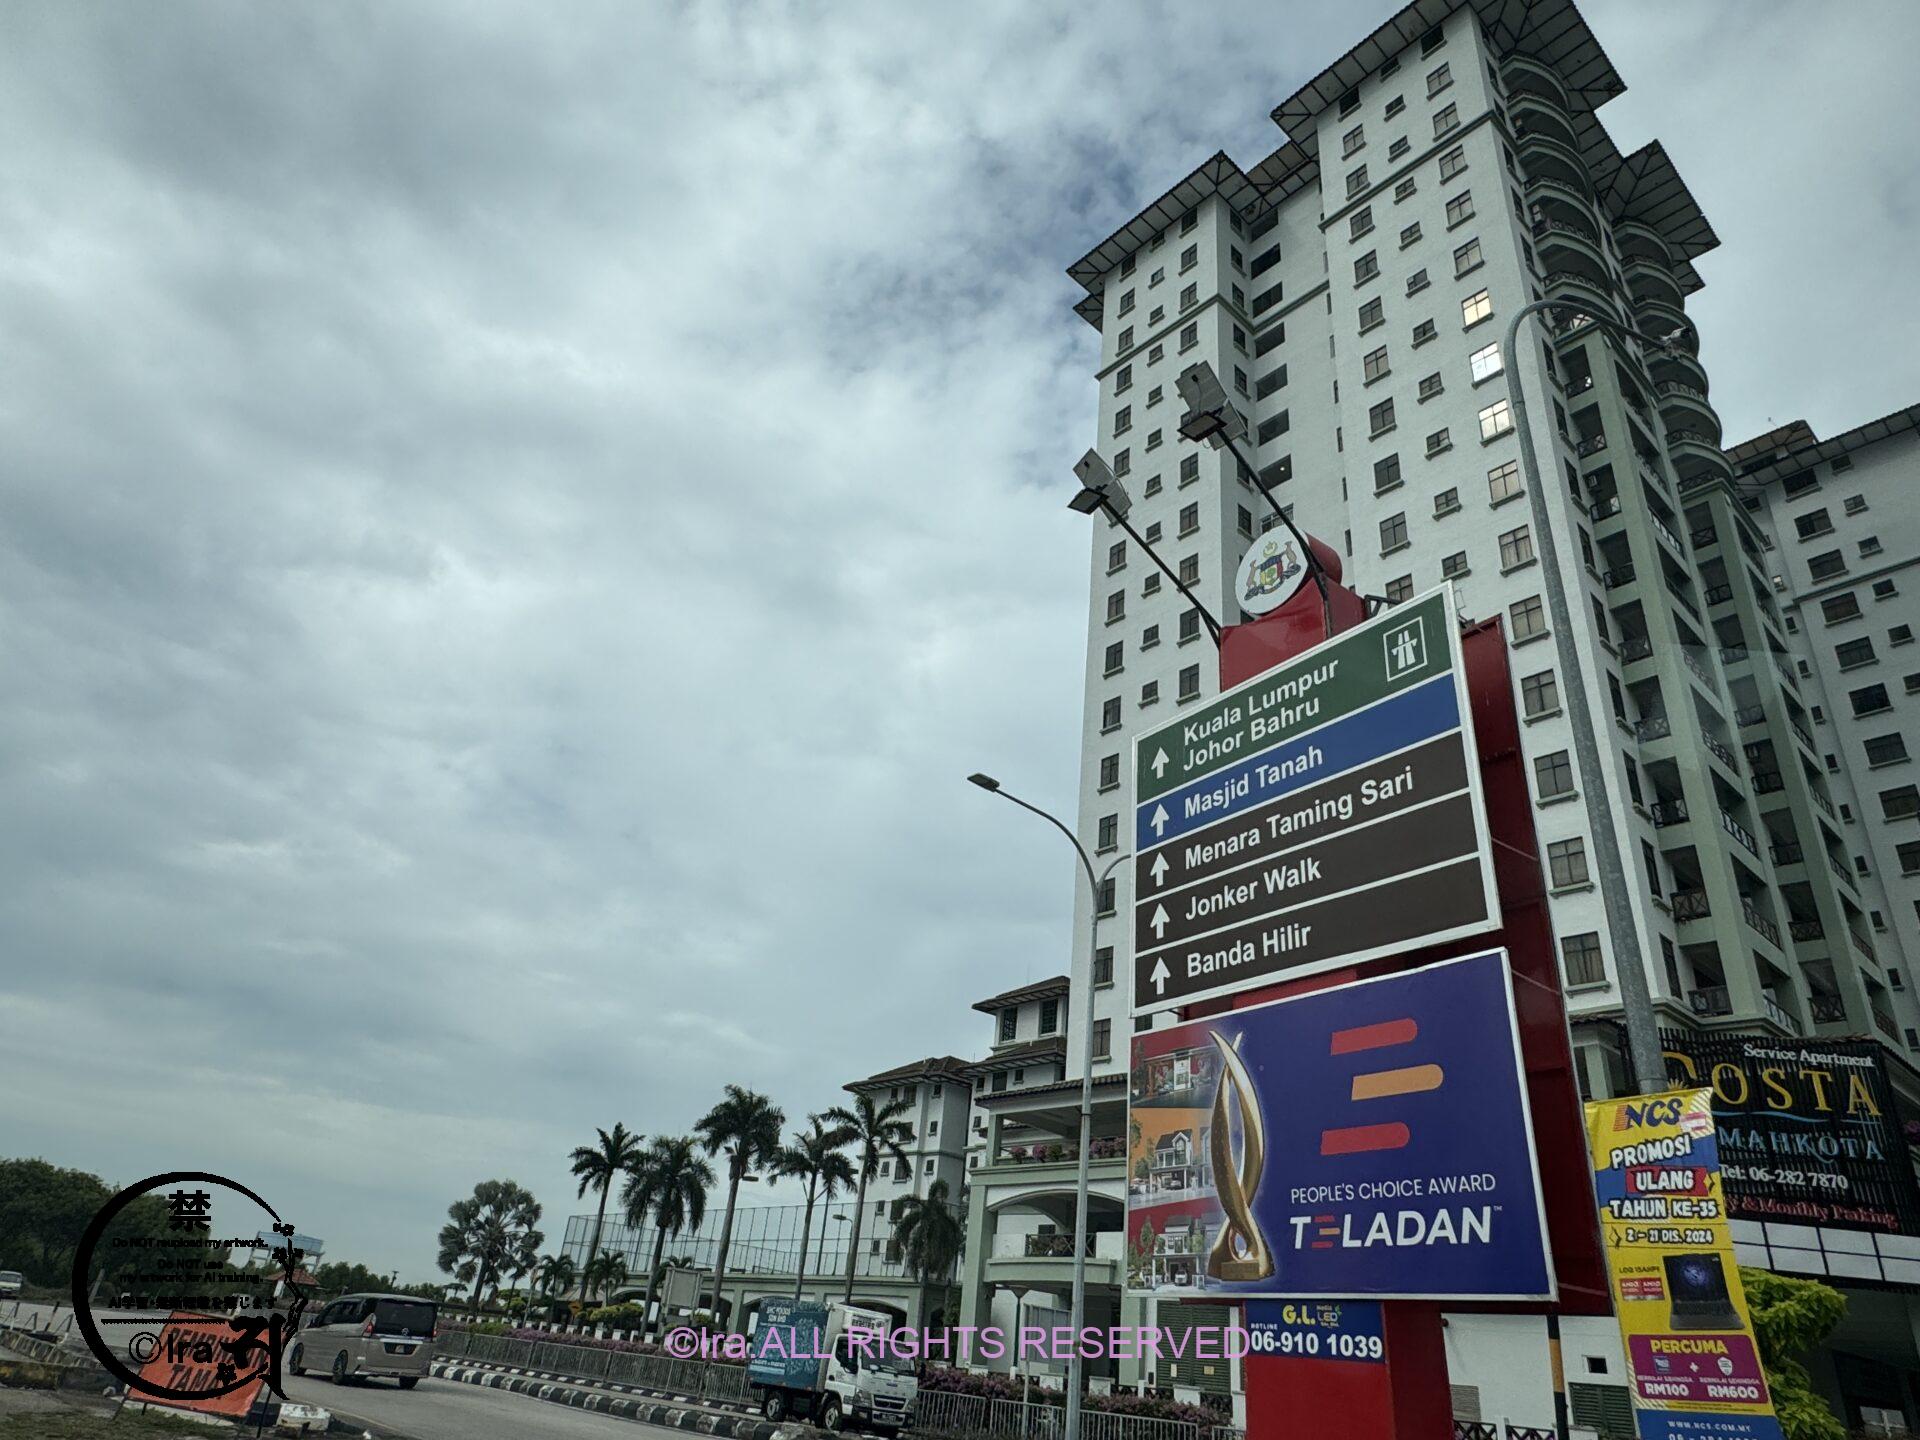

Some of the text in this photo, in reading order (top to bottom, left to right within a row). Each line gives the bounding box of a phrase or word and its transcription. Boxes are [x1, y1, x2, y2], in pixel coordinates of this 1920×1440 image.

[1184, 660, 1339, 746] Kuala Lumpur
[1183, 698, 1320, 771] Johor Bahru
[1184, 746, 1323, 819] Masjid Tanah
[1185, 765, 1413, 869] Menara Taming Sari
[1185, 857, 1322, 921] Jonker Walk
[1186, 923, 1312, 978] Banda Hilir
[1744, 1043, 1875, 1067] Service Apartment
[1613, 1098, 1684, 1131] NCS
[1611, 1134, 1692, 1169] PROMOSI
[1718, 1126, 1886, 1164] MAHKOTA
[1291, 1173, 1496, 1204] PEOPLE'S CHOICE AWARD
[1636, 1170, 1695, 1191] ULANG
[1749, 1166, 1806, 1186] 06-282
[1808, 1172, 1849, 1190] 7870
[1609, 1199, 1668, 1218] TAHUN
[1672, 1200, 1718, 1218] KE-35
[1684, 1230, 1714, 1244] 2024
[1250, 1330, 1383, 1359] 06-910 1039
[1650, 1339, 1729, 1354] PERCUMA
[1644, 1382, 1689, 1397] RM100
[1707, 1385, 1759, 1399] RM600
